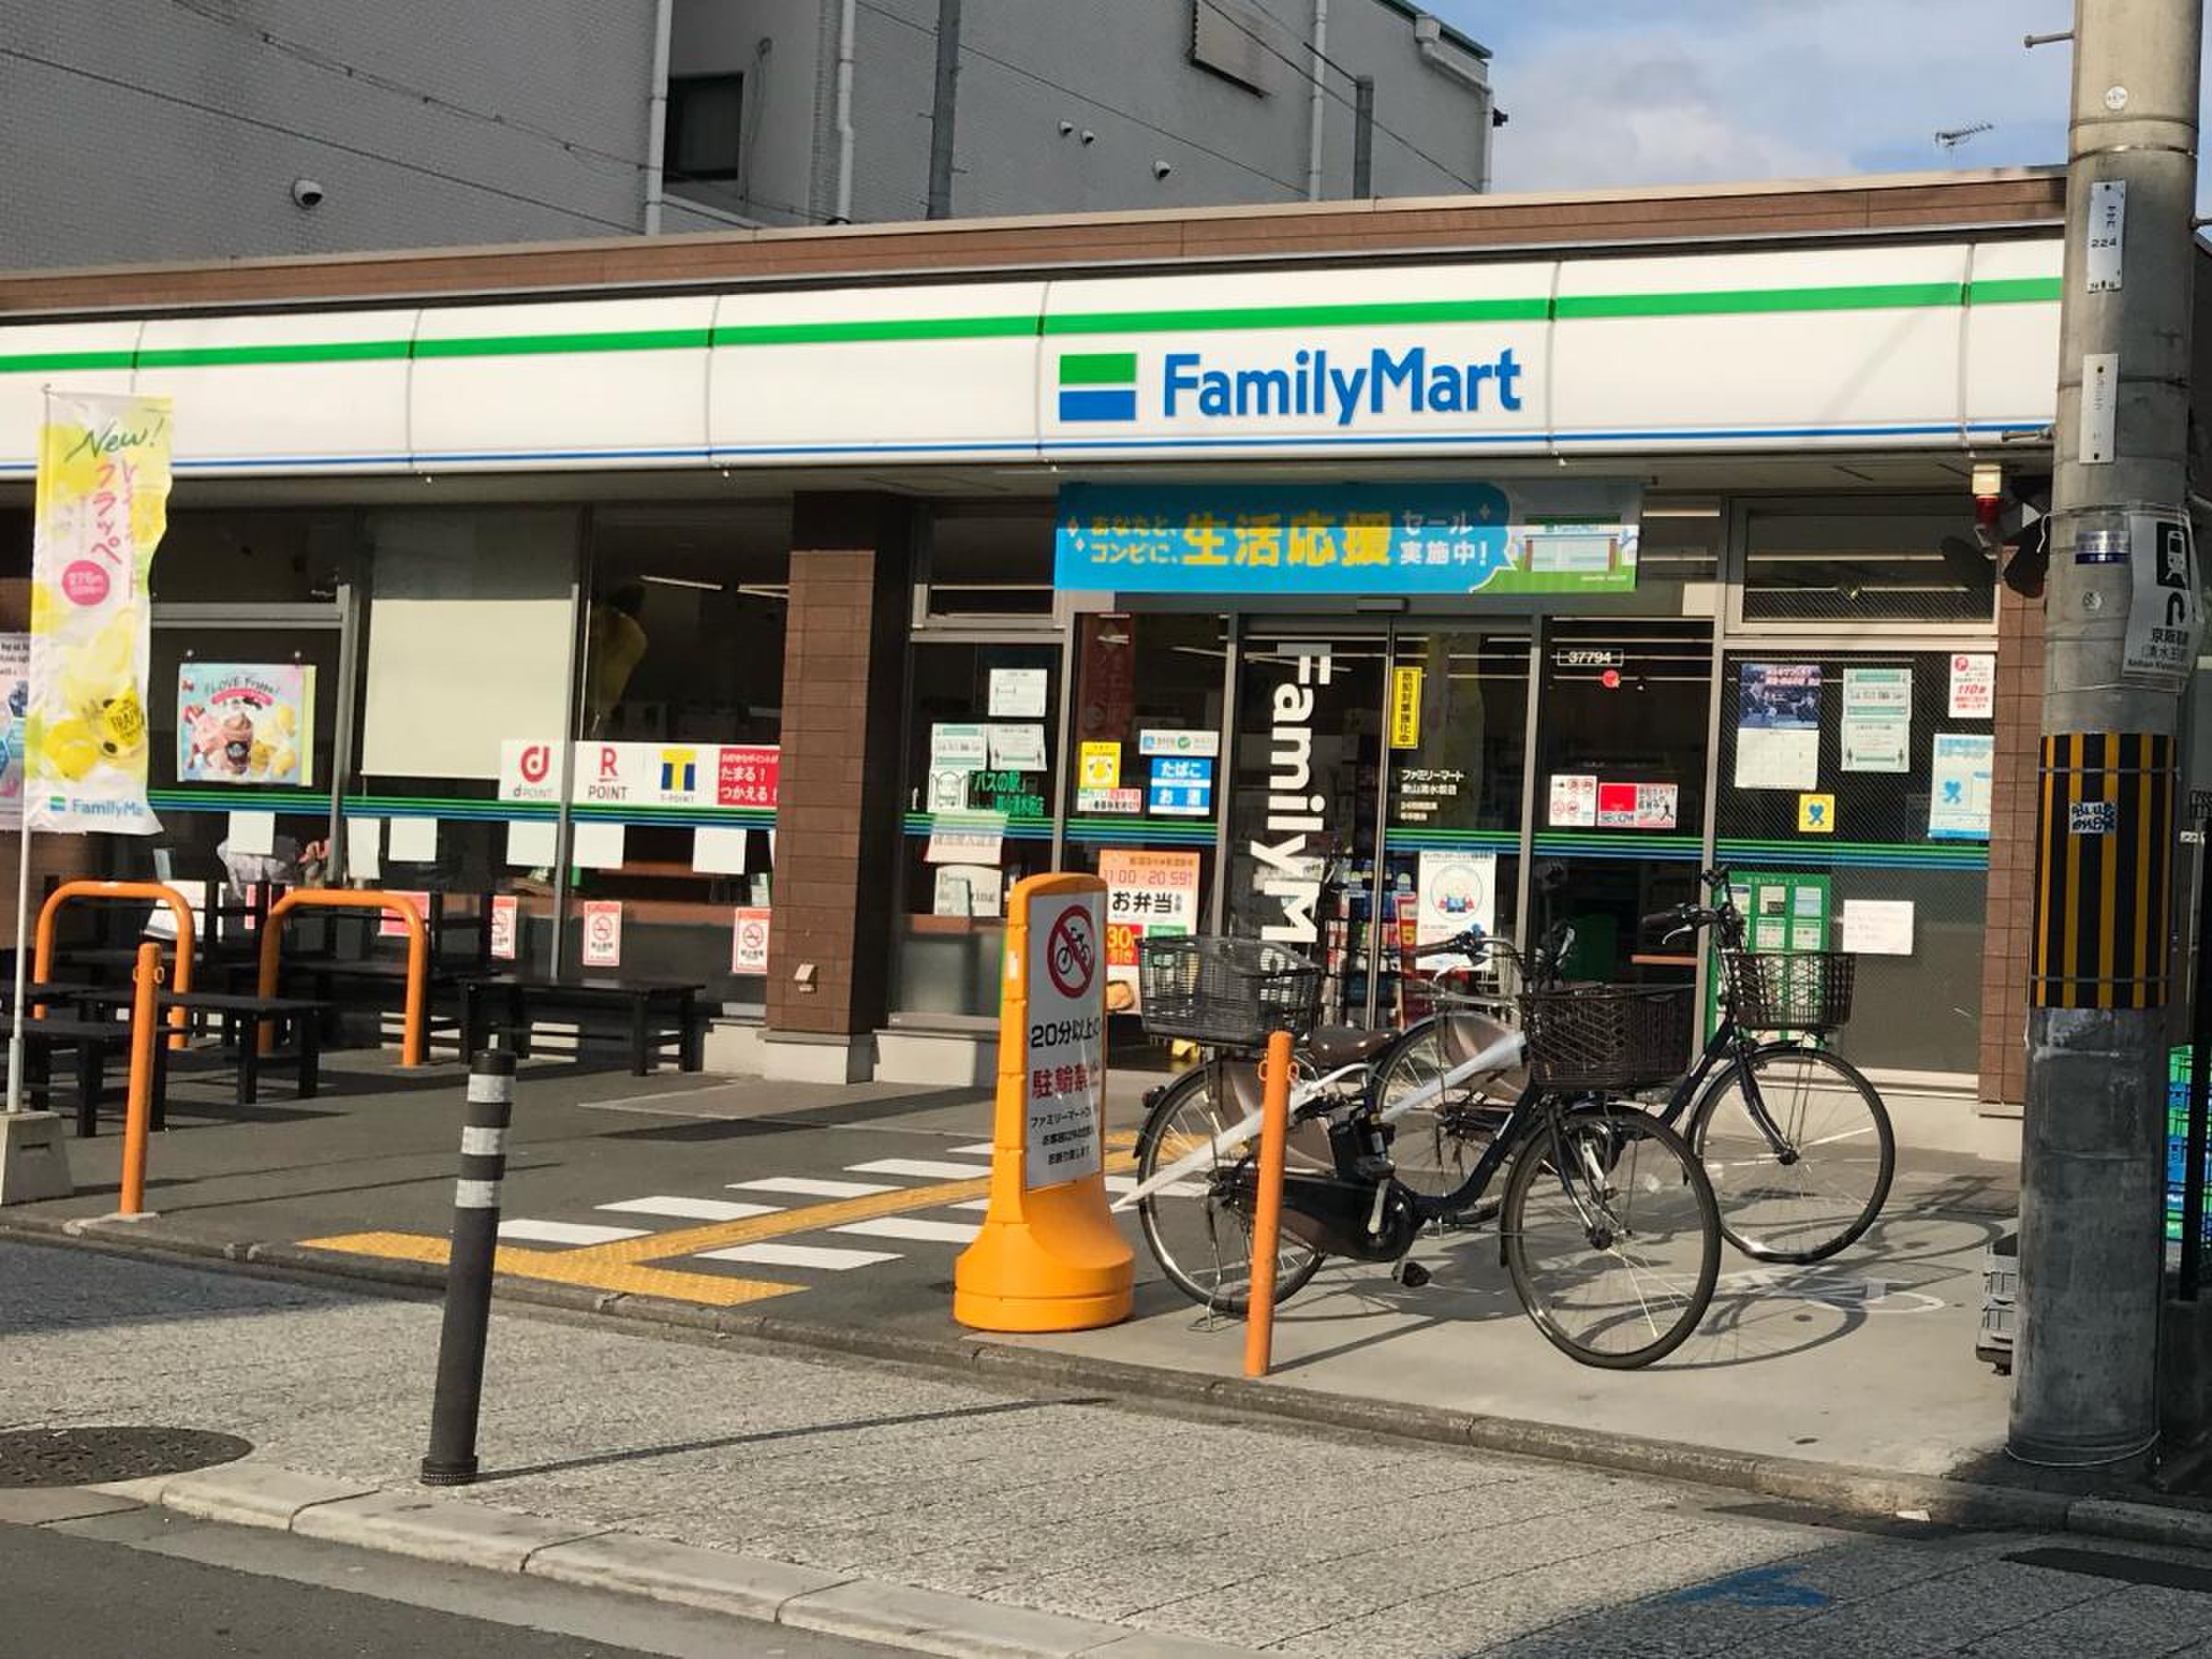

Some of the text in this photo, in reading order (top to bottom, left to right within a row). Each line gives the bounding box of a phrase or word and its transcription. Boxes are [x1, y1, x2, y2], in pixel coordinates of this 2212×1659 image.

[1164, 347, 1521, 426] FamilyMart
[65, 418, 164, 463] New!
[1402, 511, 1474, 536] セール
[1182, 512, 1391, 568] 生活応援
[1569, 650, 1612, 665] 37794
[1402, 771, 1464, 782] ファミリーマート
[588, 784, 629, 801] POINT
[1112, 891, 1172, 913] お弁当
